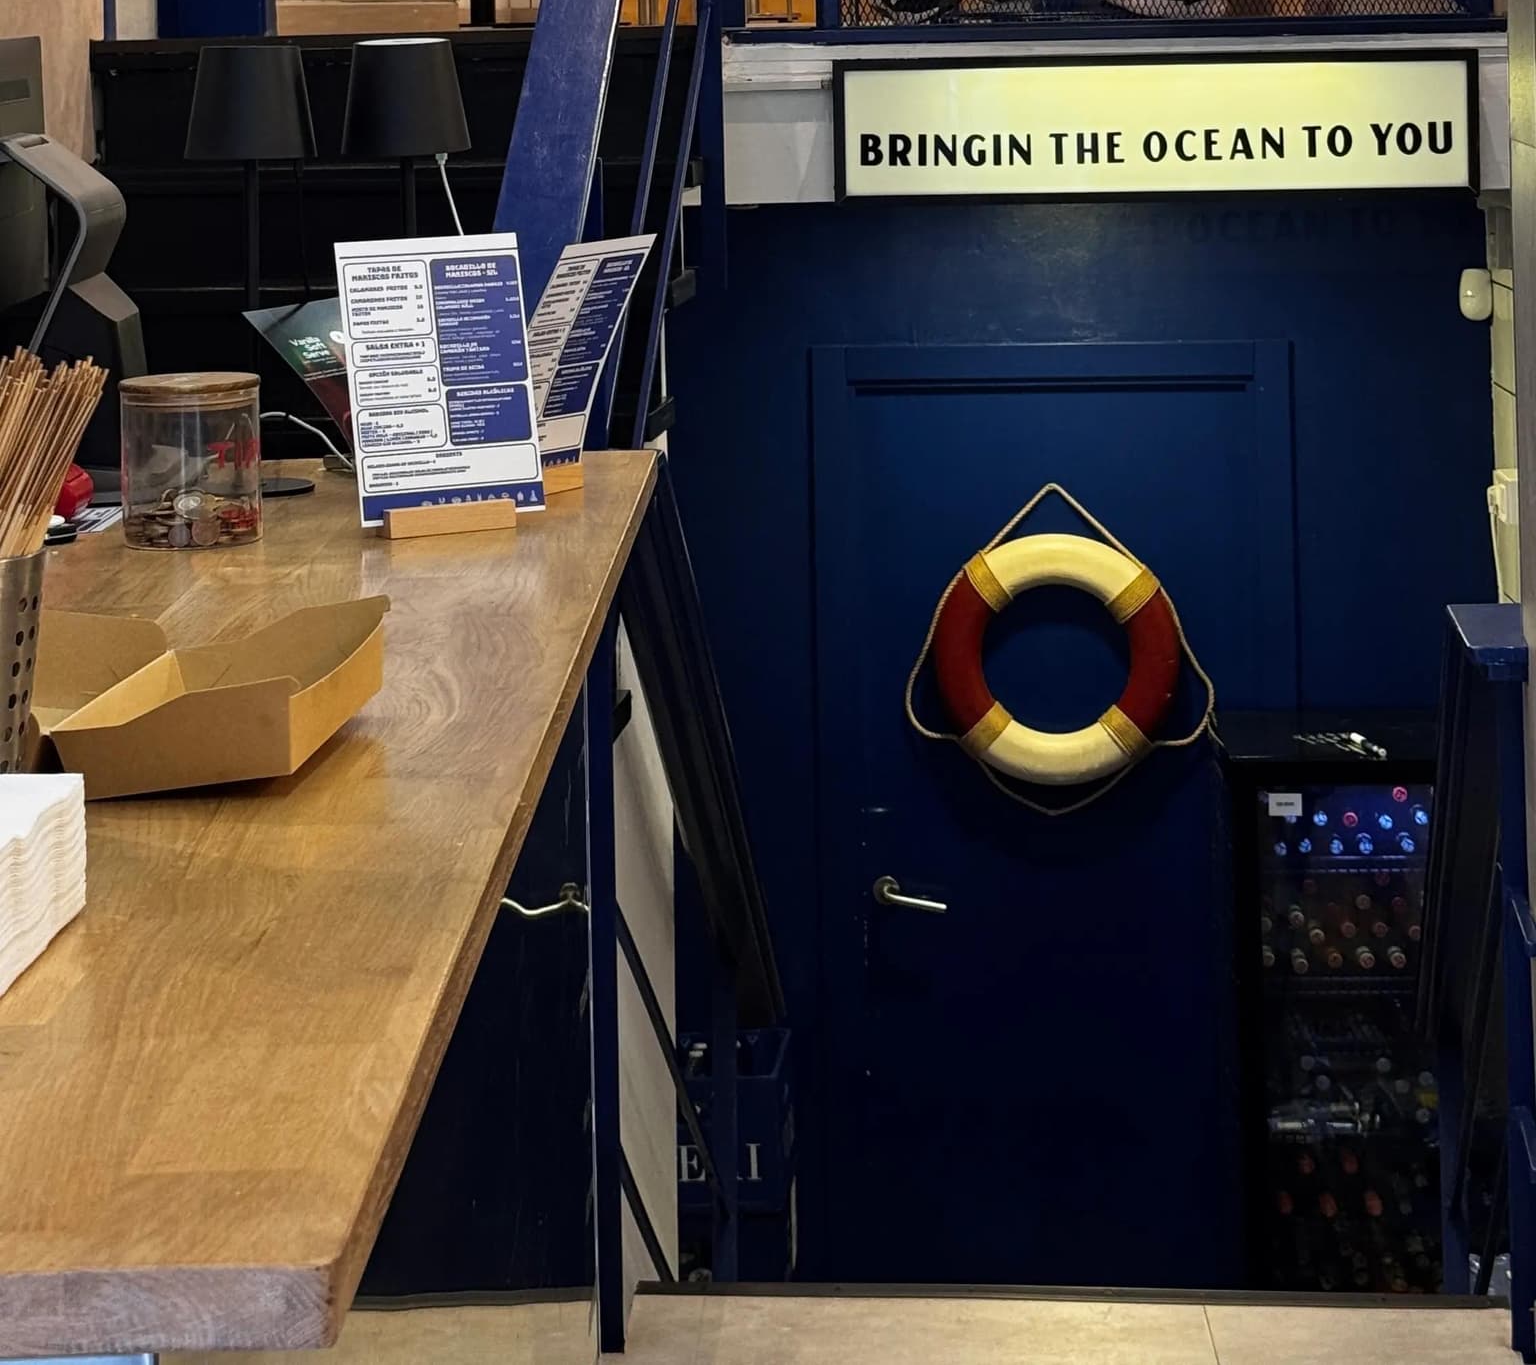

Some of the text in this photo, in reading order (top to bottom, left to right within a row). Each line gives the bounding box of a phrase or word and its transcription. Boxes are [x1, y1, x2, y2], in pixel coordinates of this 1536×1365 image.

[860, 120, 1453, 167] BRINGIN THE OCEAN TO YOU
